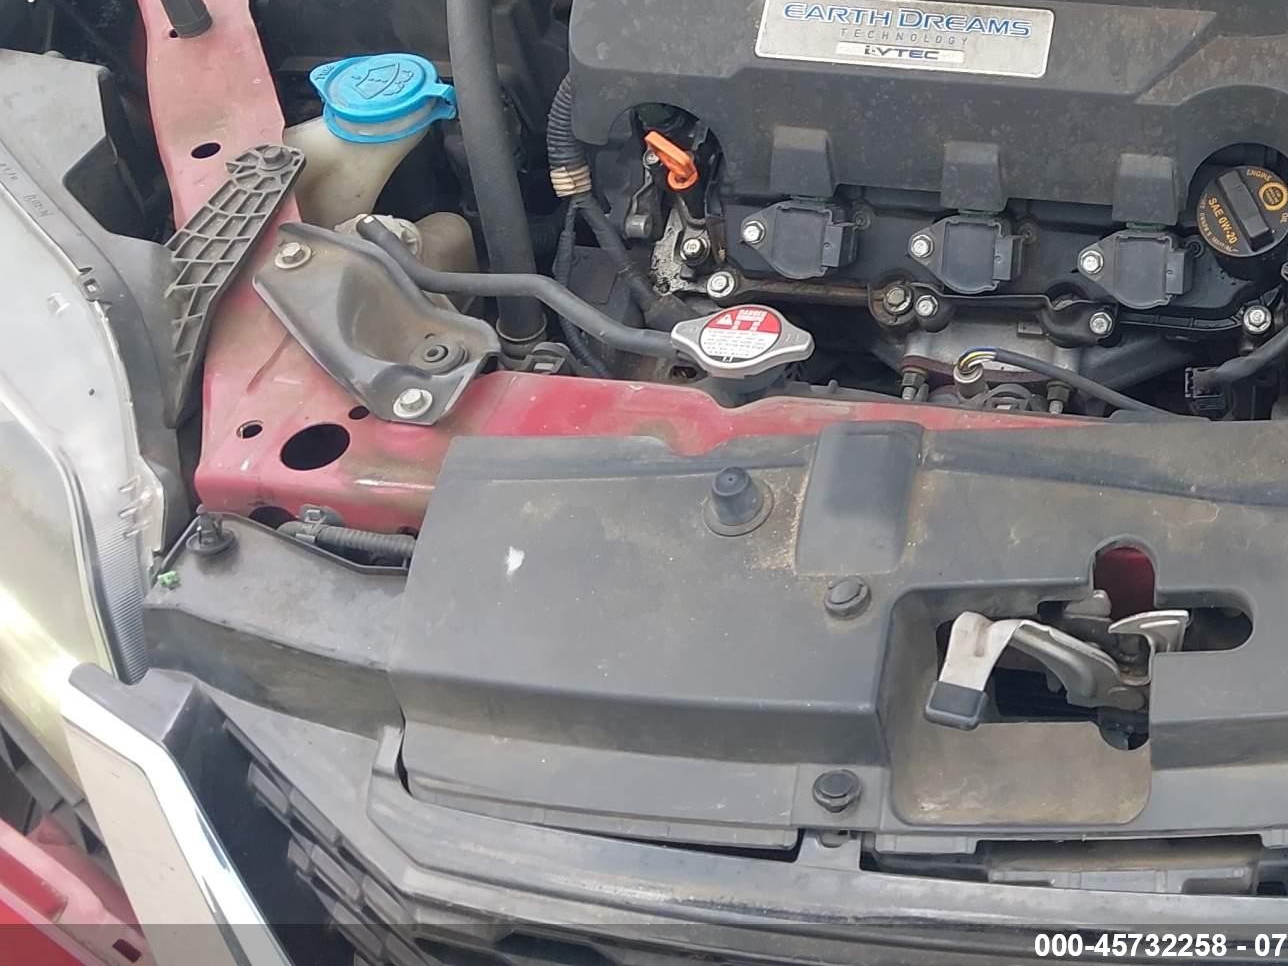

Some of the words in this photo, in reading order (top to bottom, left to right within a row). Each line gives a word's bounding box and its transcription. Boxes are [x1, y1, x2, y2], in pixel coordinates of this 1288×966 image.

[783, 1, 893, 26] EARTH
[898, 8, 1033, 37] DREAMS
[840, 28, 969, 46] TECHNOLOGY
[1246, 169, 1272, 181] ENGINE
[1208, 197, 1225, 218] SAE
[1218, 217, 1238, 244] 0W-20
